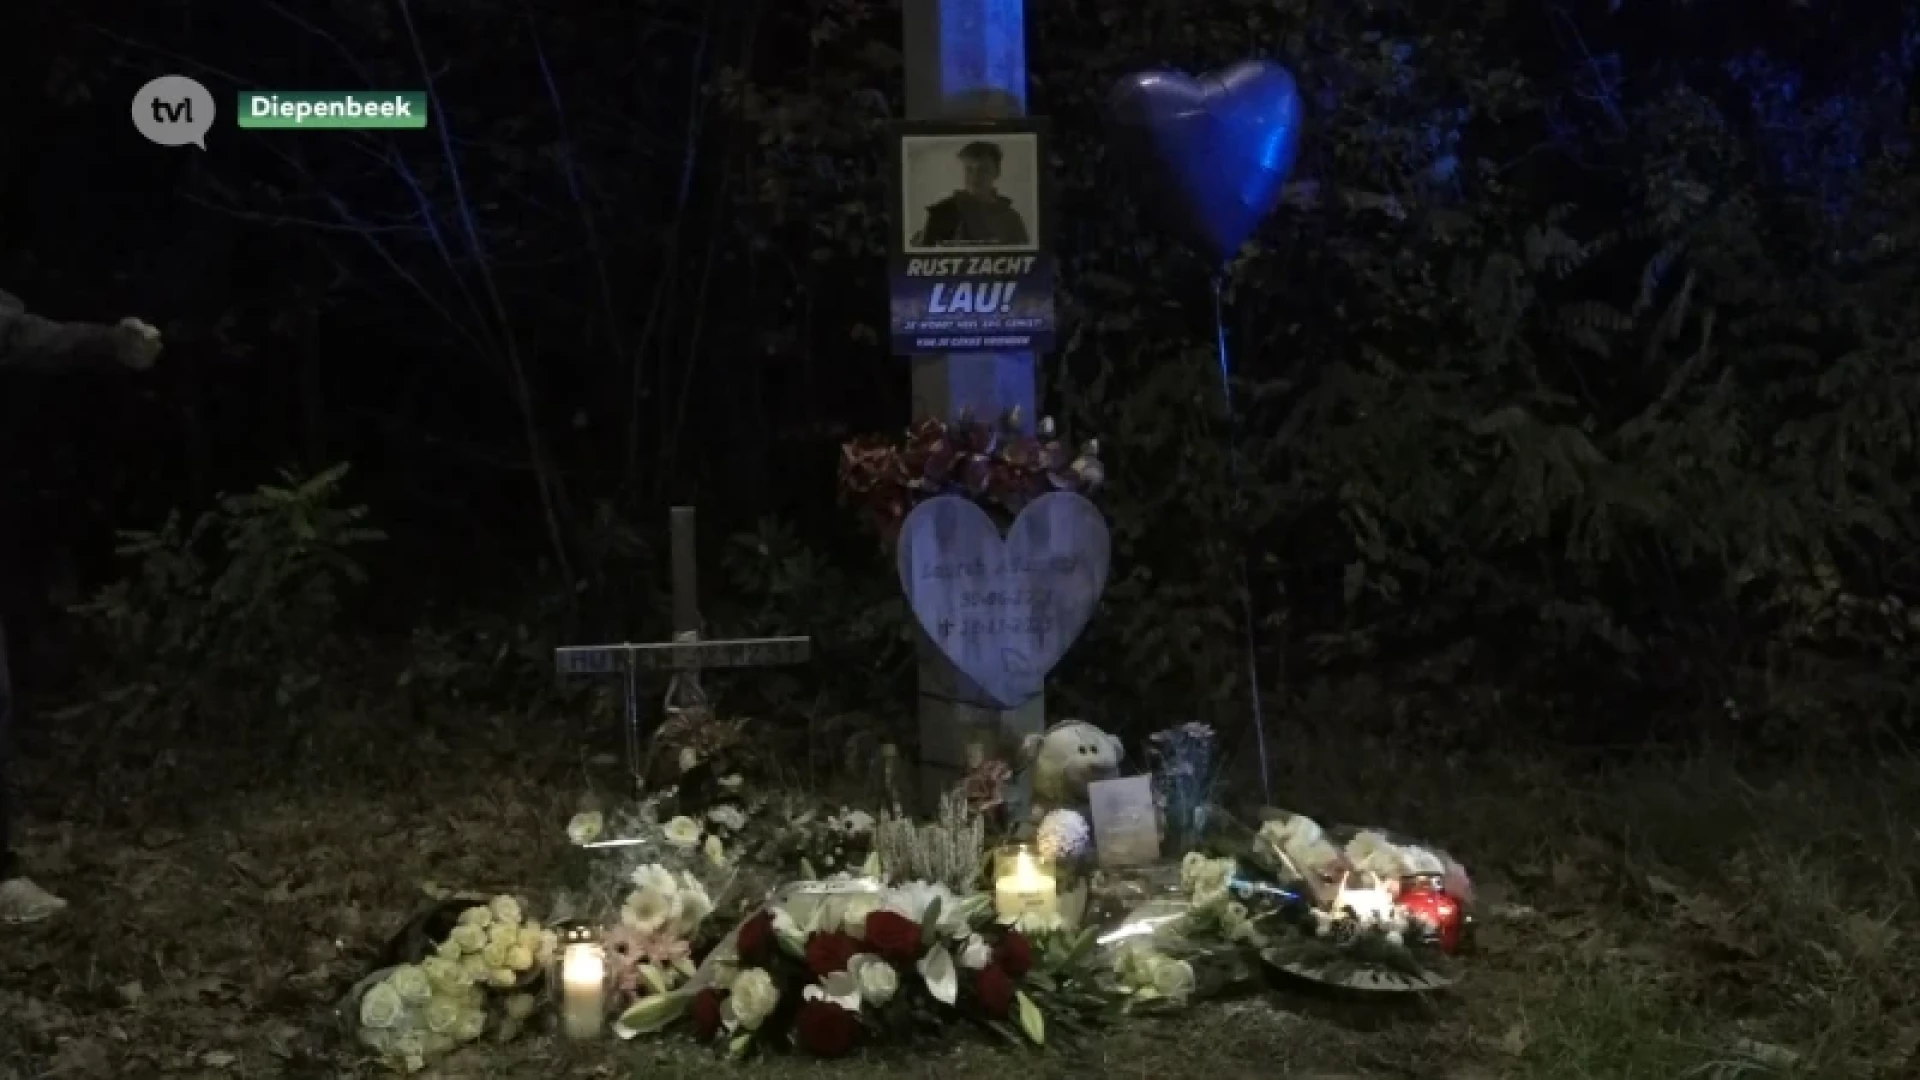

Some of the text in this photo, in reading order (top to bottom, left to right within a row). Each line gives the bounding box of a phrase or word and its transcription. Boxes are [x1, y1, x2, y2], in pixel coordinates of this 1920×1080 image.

[906, 256, 1037, 276] RUST ZACHT
[928, 281, 1017, 313] LAU!
